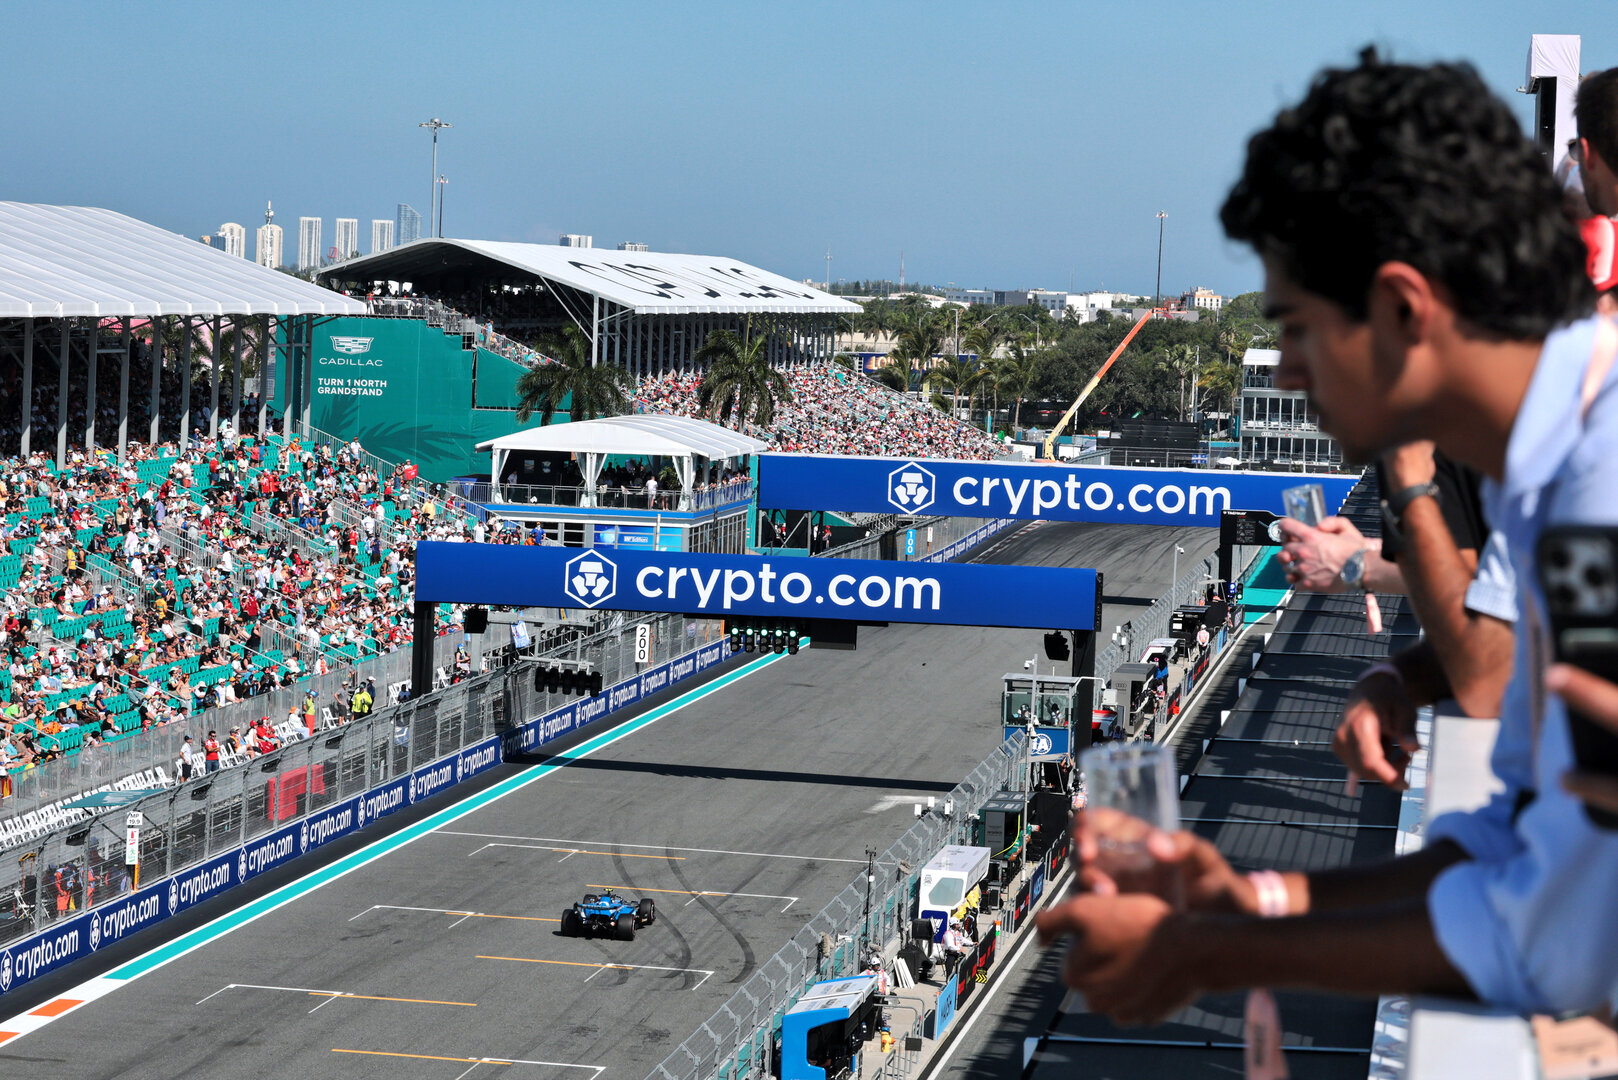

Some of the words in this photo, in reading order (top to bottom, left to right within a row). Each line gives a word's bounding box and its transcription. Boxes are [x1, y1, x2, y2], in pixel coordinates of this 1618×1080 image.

[319, 358, 383, 366] CADILLAC
[317, 387, 383, 396] GRANDSTAND
[318, 378, 344, 386] TURN
[353, 379, 387, 387] NORTH
[953, 474, 1231, 516] crypto.com
[636, 563, 941, 610] crypto.com
[638, 627, 646, 660] 200
[464, 746, 495, 775] crypto.com
[417, 764, 451, 795] crypto.com
[366, 786, 403, 819] crypto.com
[310, 808, 351, 844] crypto.com
[248, 834, 293, 872] crypto.com
[180, 862, 230, 904] crypto.com
[103, 893, 159, 939] crypto.com
[15, 929, 79, 979] crypto.com
